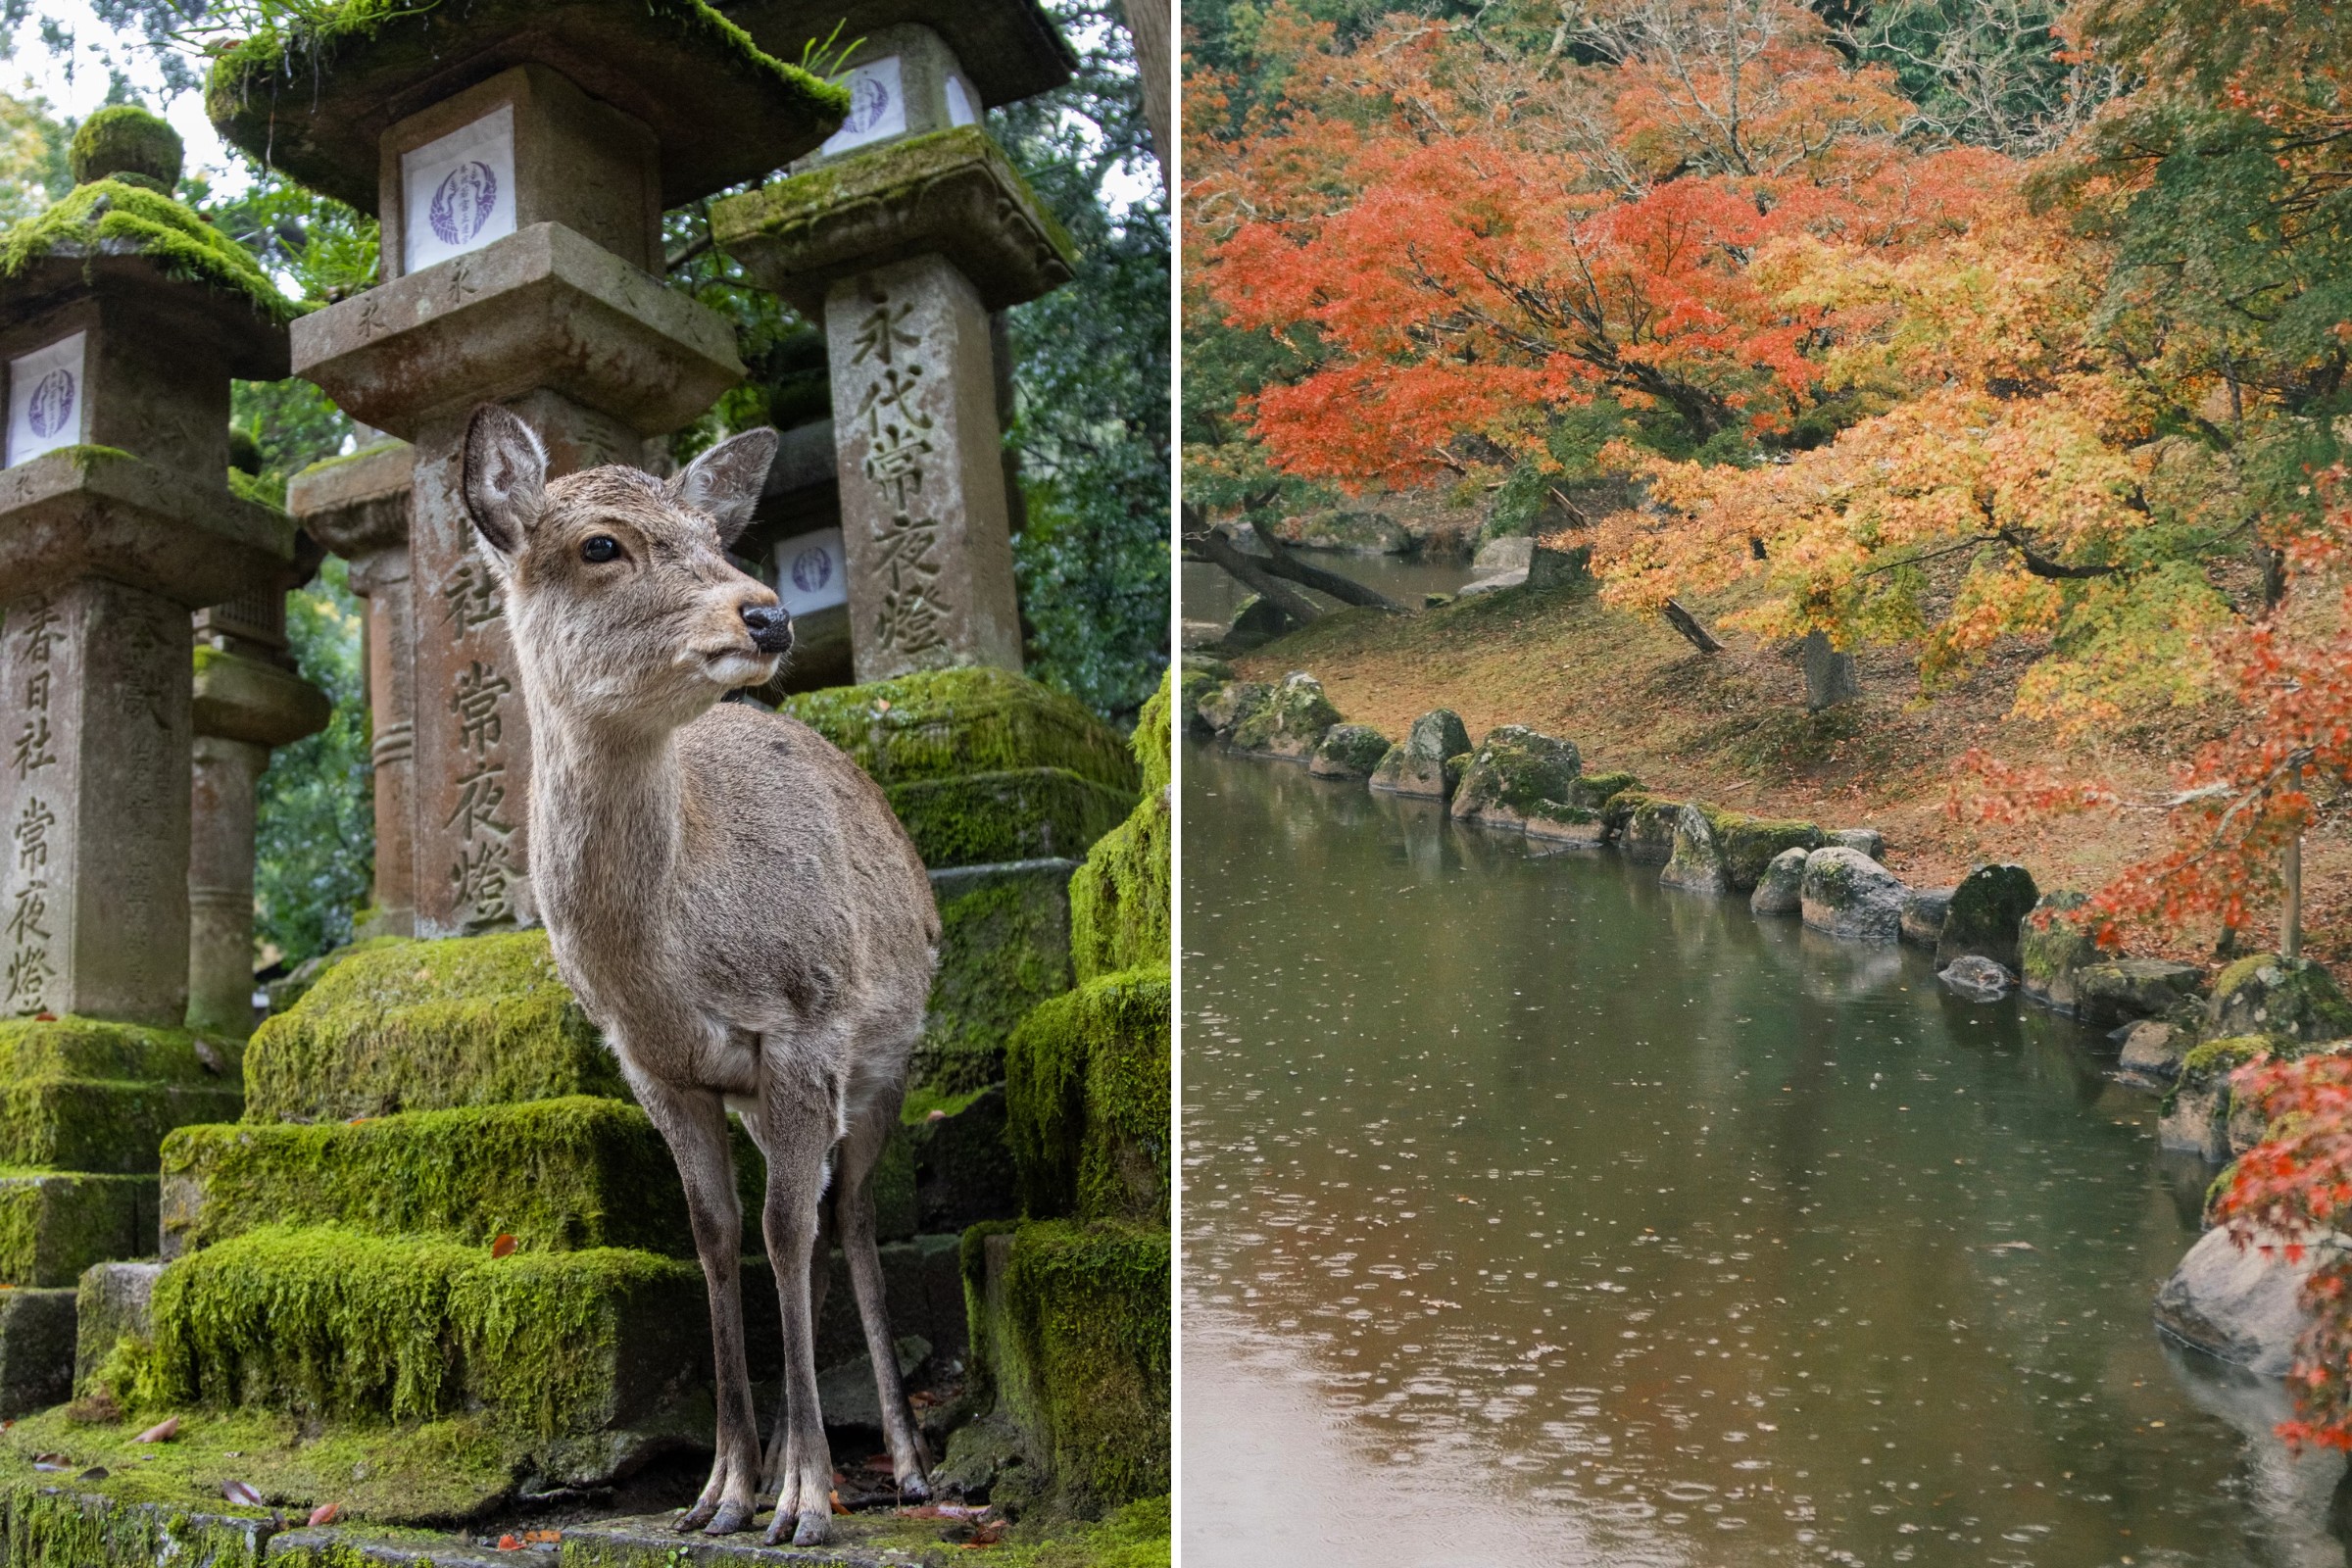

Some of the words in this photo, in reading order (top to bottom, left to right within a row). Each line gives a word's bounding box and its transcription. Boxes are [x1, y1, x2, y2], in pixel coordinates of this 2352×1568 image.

[851, 293, 953, 655] 永代常夜燈
[5, 596, 67, 1015] 春日社常夜燈
[438, 451, 529, 926] 社常夜燈
